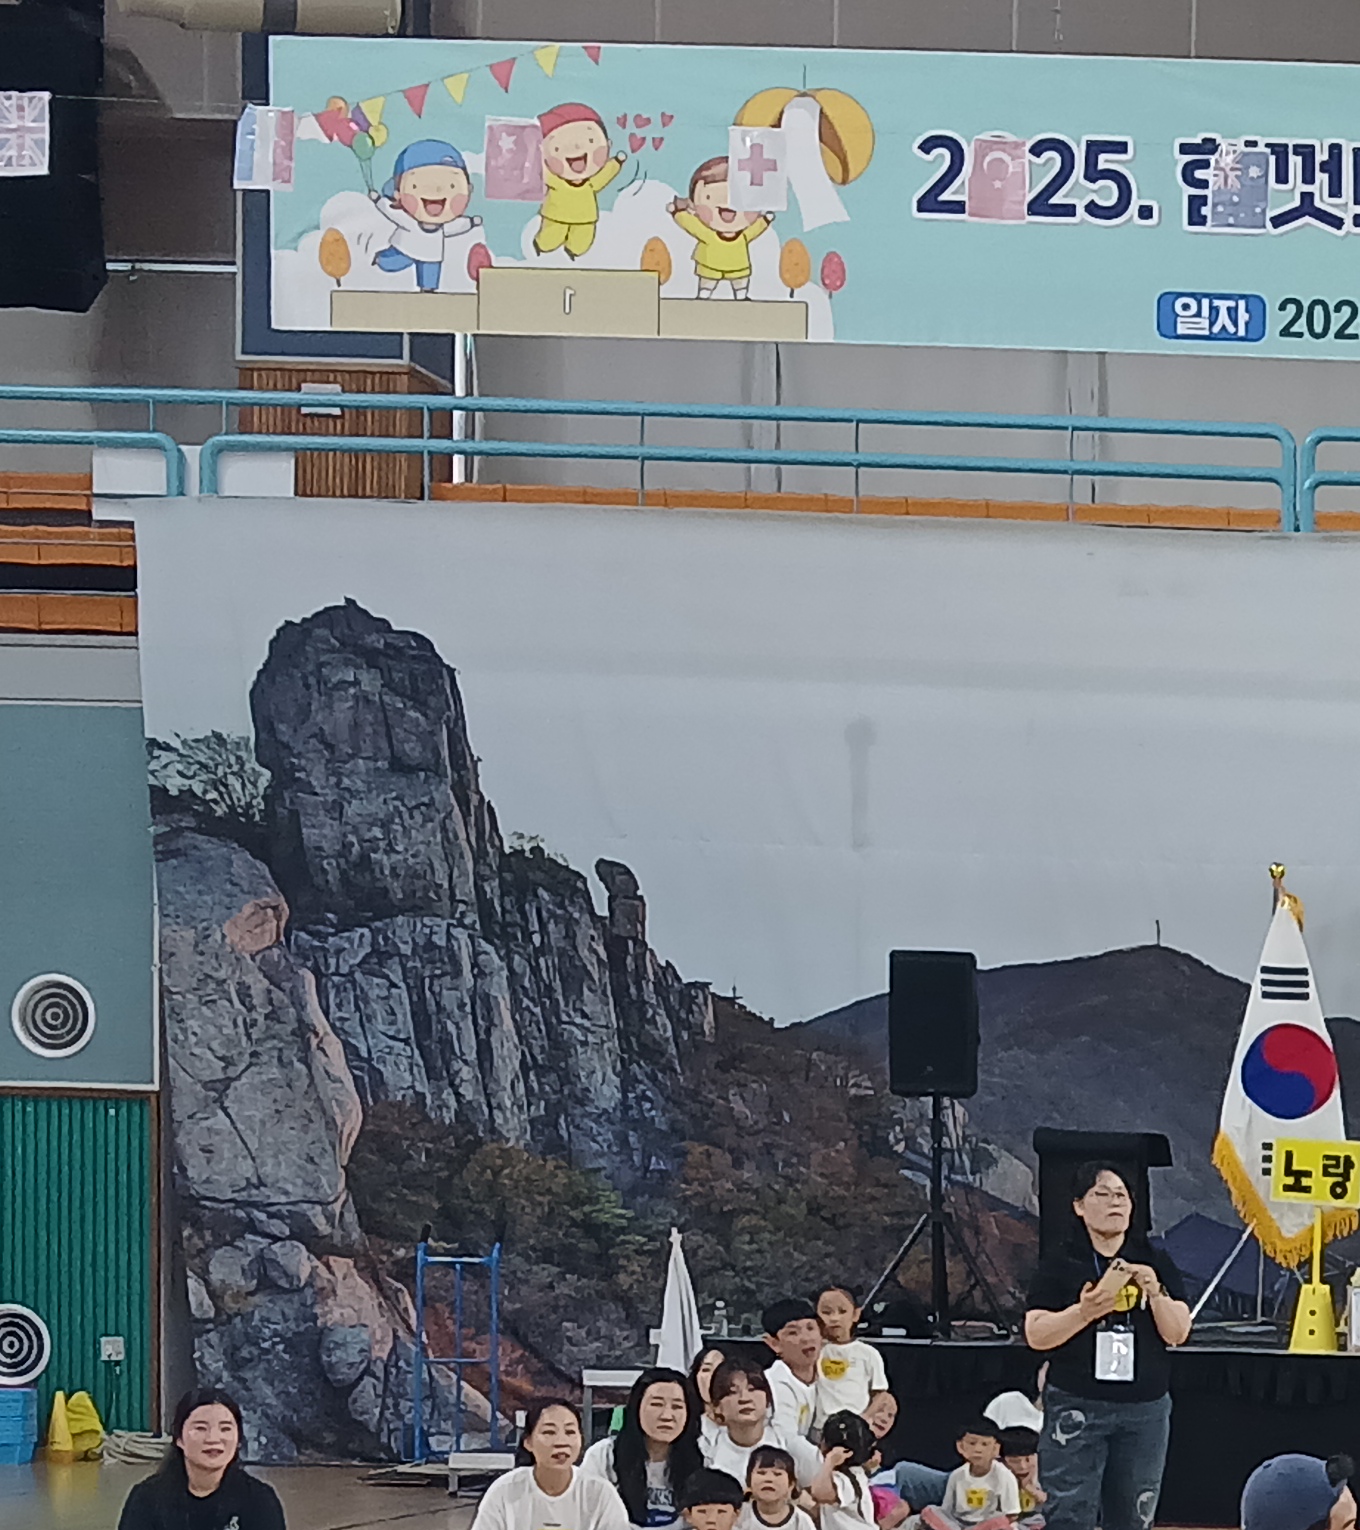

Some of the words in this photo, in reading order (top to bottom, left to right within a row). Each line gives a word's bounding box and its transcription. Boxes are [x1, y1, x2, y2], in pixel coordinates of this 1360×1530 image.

[915, 133, 1156, 222] 225.
[1172, 296, 1252, 339] 일자
[1282, 1149, 1356, 1201] 노랑
